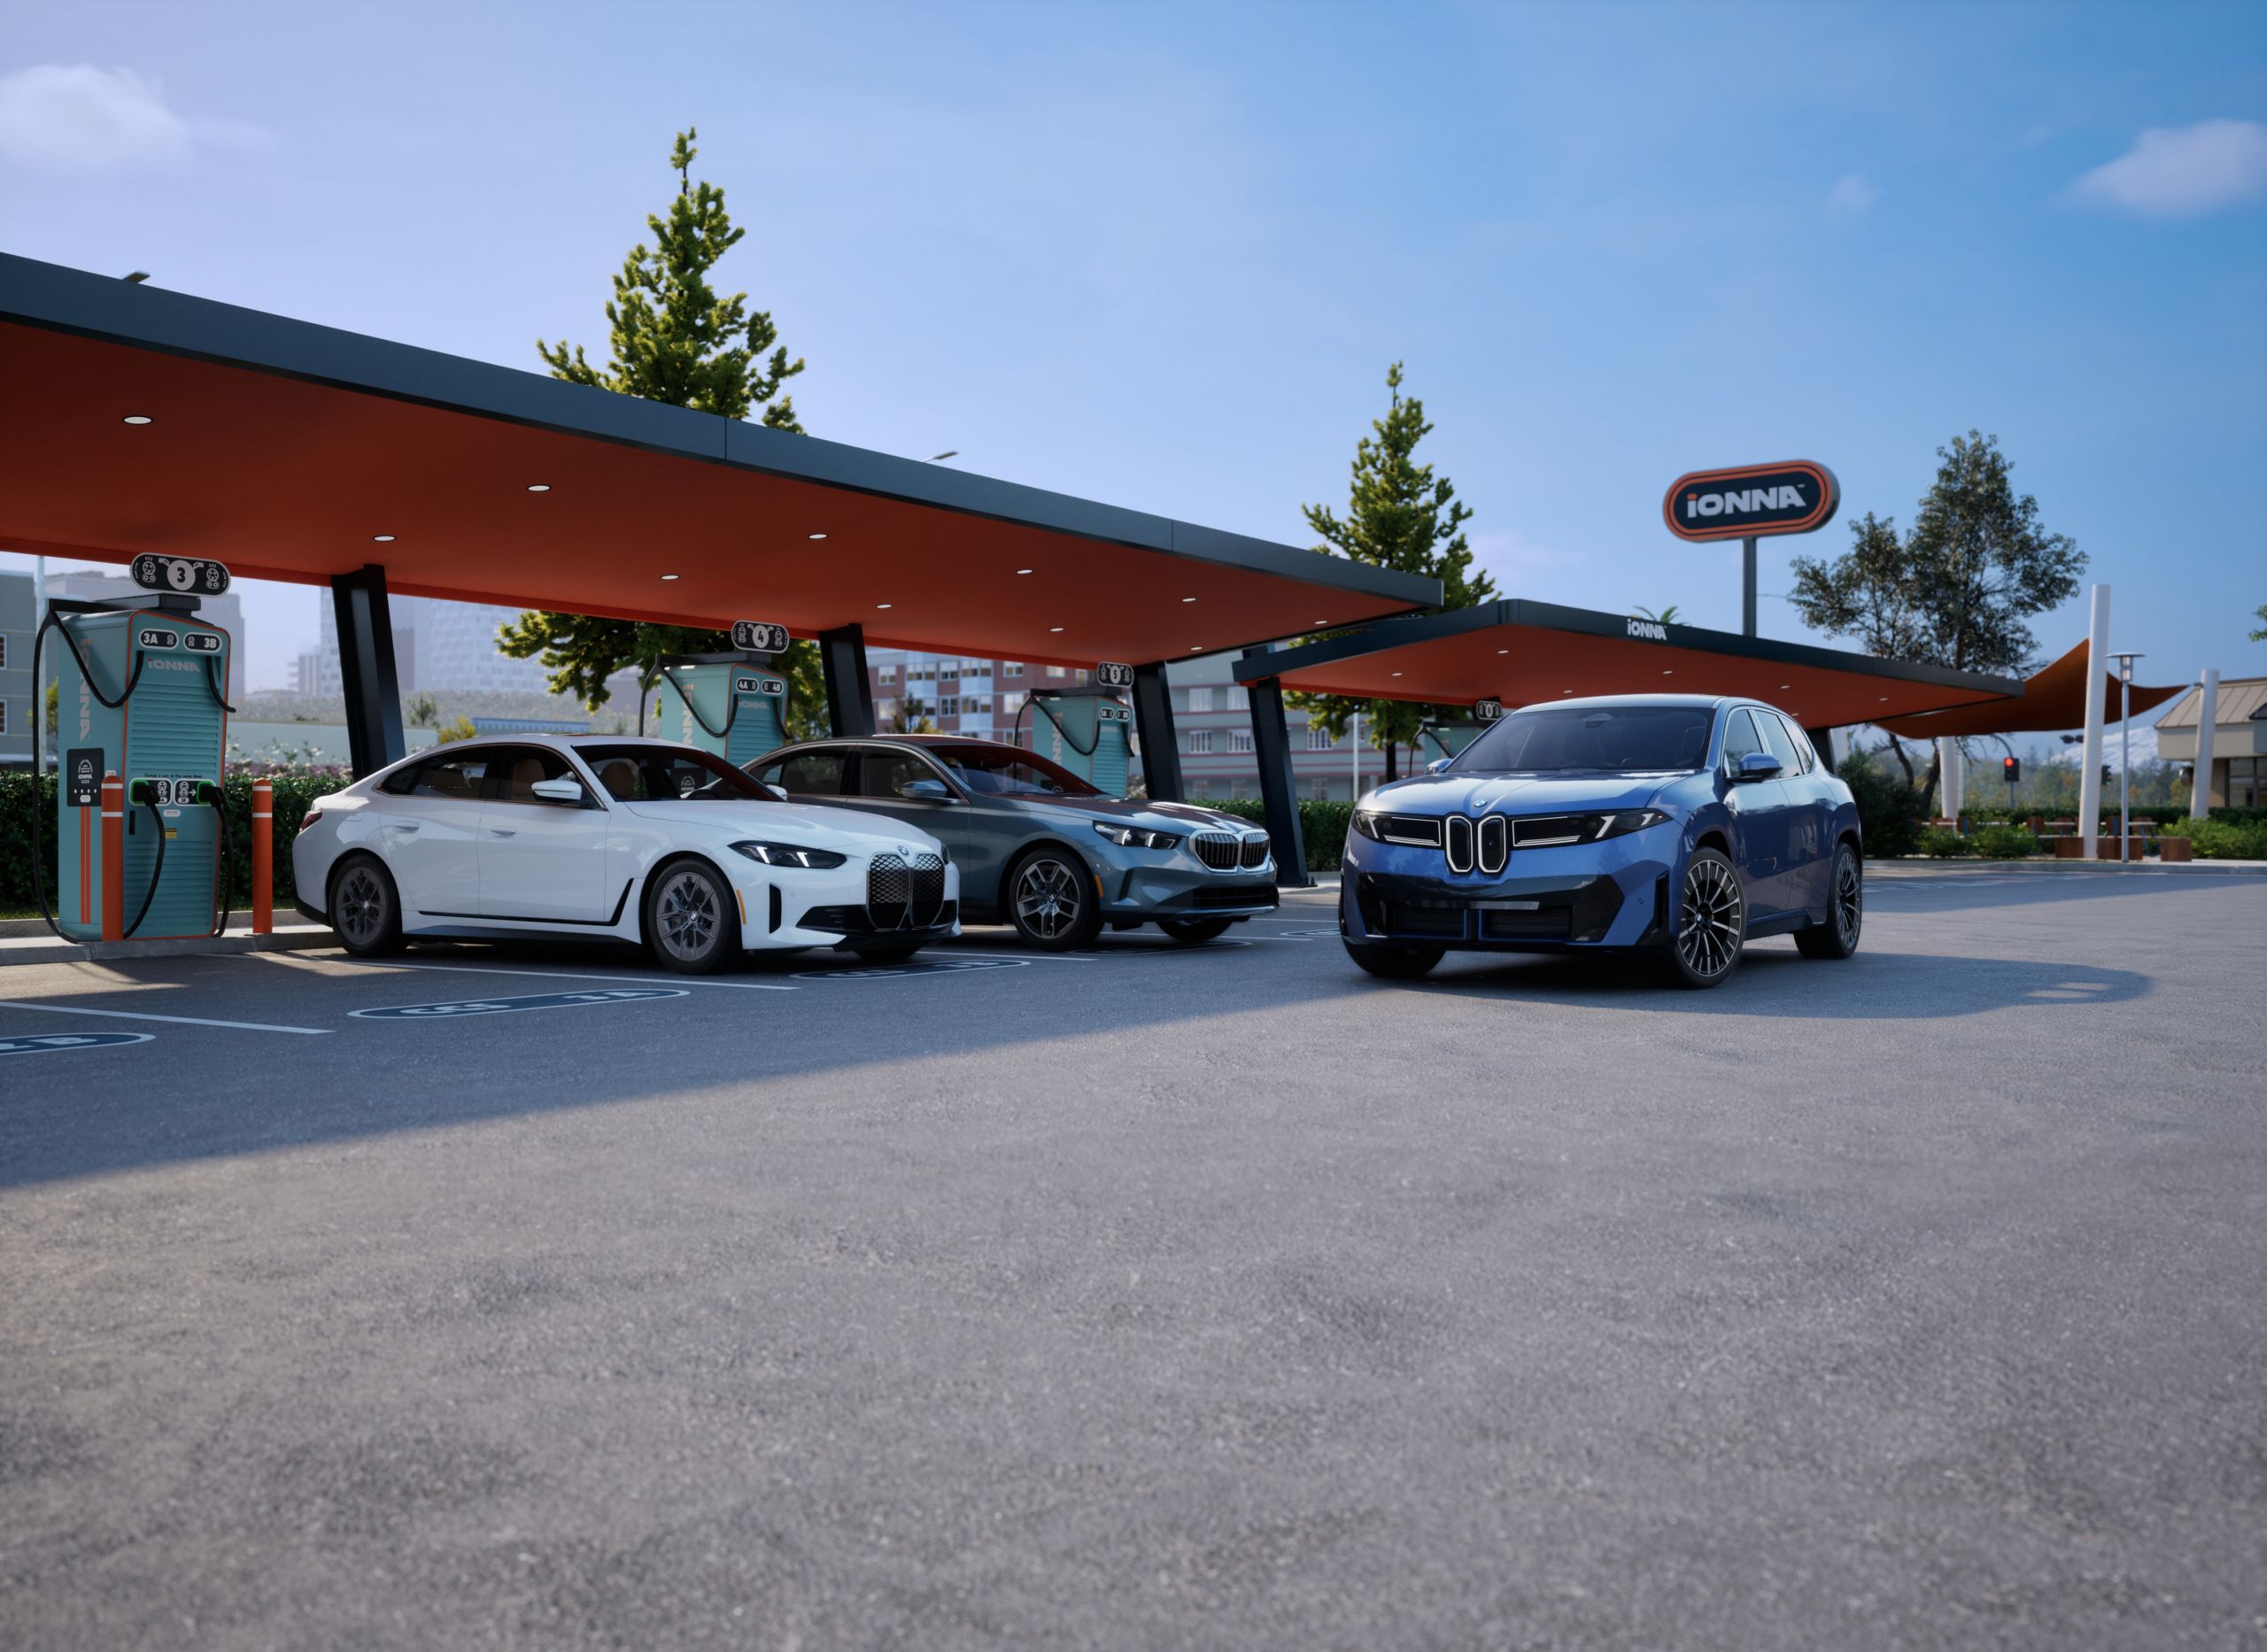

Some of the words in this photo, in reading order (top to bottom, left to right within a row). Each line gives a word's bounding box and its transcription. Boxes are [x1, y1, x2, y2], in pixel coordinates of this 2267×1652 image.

[176, 567, 186, 583] 3
[1627, 618, 1667, 641] iONNA
[143, 633, 159, 645] 3A
[758, 630, 764, 643] 4
[204, 637, 217, 649] 3B
[739, 681, 748, 690] 4A
